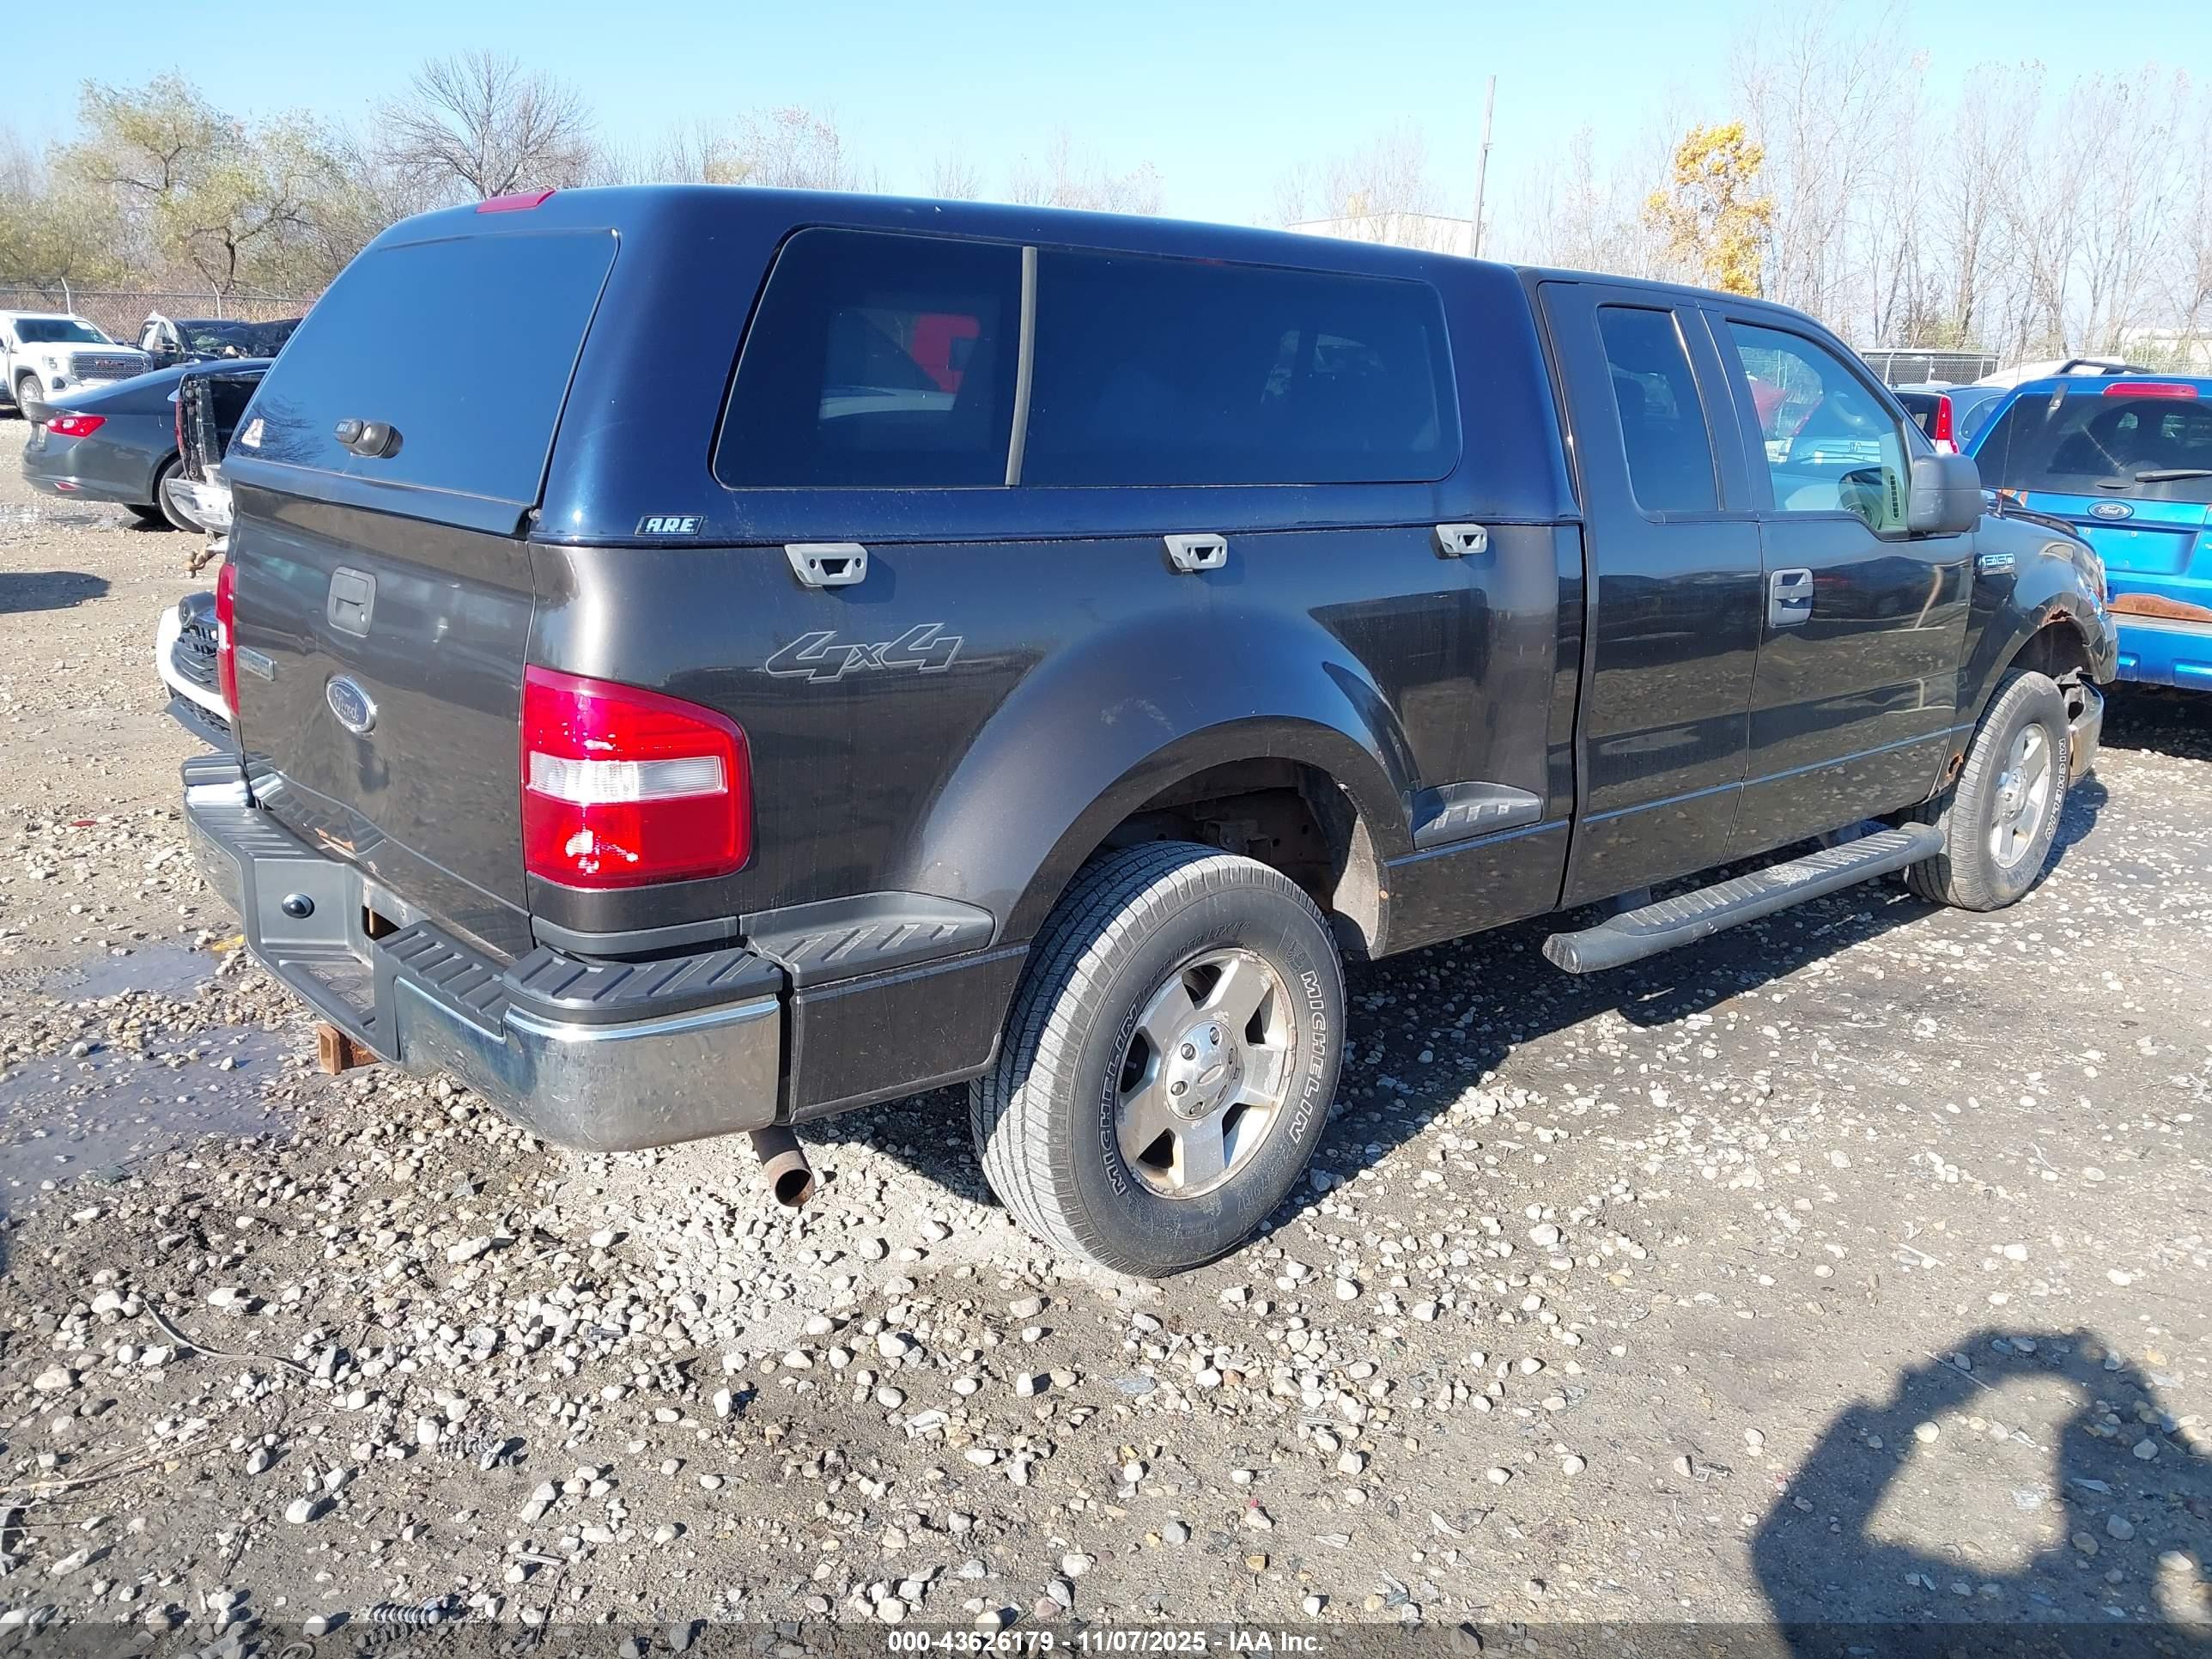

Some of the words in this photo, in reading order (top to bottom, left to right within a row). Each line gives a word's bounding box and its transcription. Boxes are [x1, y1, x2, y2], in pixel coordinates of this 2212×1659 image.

[333, 686, 359, 721] Ford
[765, 623, 965, 684] 4x4
[2045, 738, 2067, 841] MICHELIN
[1098, 1001, 1139, 1196] MICHELIN
[1289, 969, 1327, 1145] MICHELIN
